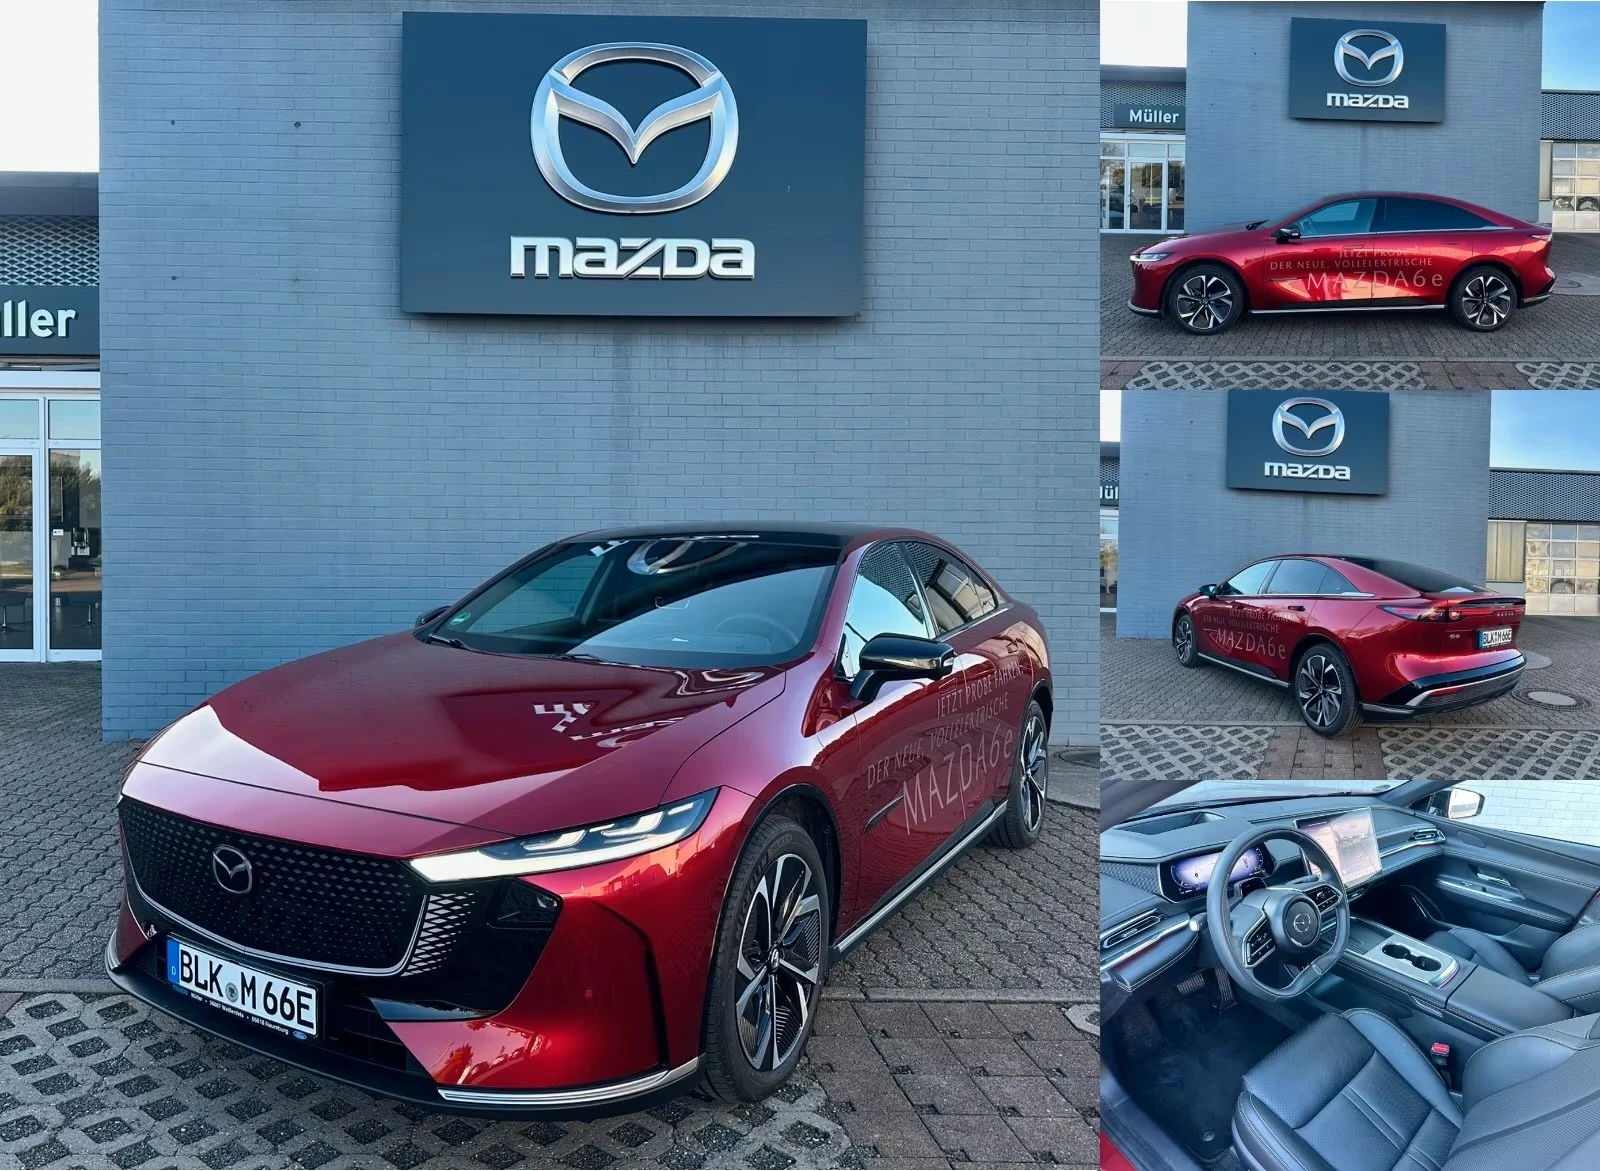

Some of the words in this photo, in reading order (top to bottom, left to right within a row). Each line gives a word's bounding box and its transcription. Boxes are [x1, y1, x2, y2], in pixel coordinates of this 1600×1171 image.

[1129, 108, 1180, 124] Müller
[1270, 261, 1292, 270] DER
[1334, 257, 1433, 268] VOLLELEKTRISCHE
[1307, 269, 1443, 291] MAZDA6e
[1215, 627, 1286, 660] MAZDA6e
[936, 689, 963, 723] JETZT
[966, 677, 994, 705] PROBE
[867, 756, 890, 790] DER
[929, 691, 1009, 748] VOLLELEKTRISCHE
[903, 722, 1013, 836] MAZDA6e
[171, 965, 177, 976] D
[180, 949, 224, 998] BLK
[240, 971, 257, 1010] M
[263, 980, 315, 1030] 66E
